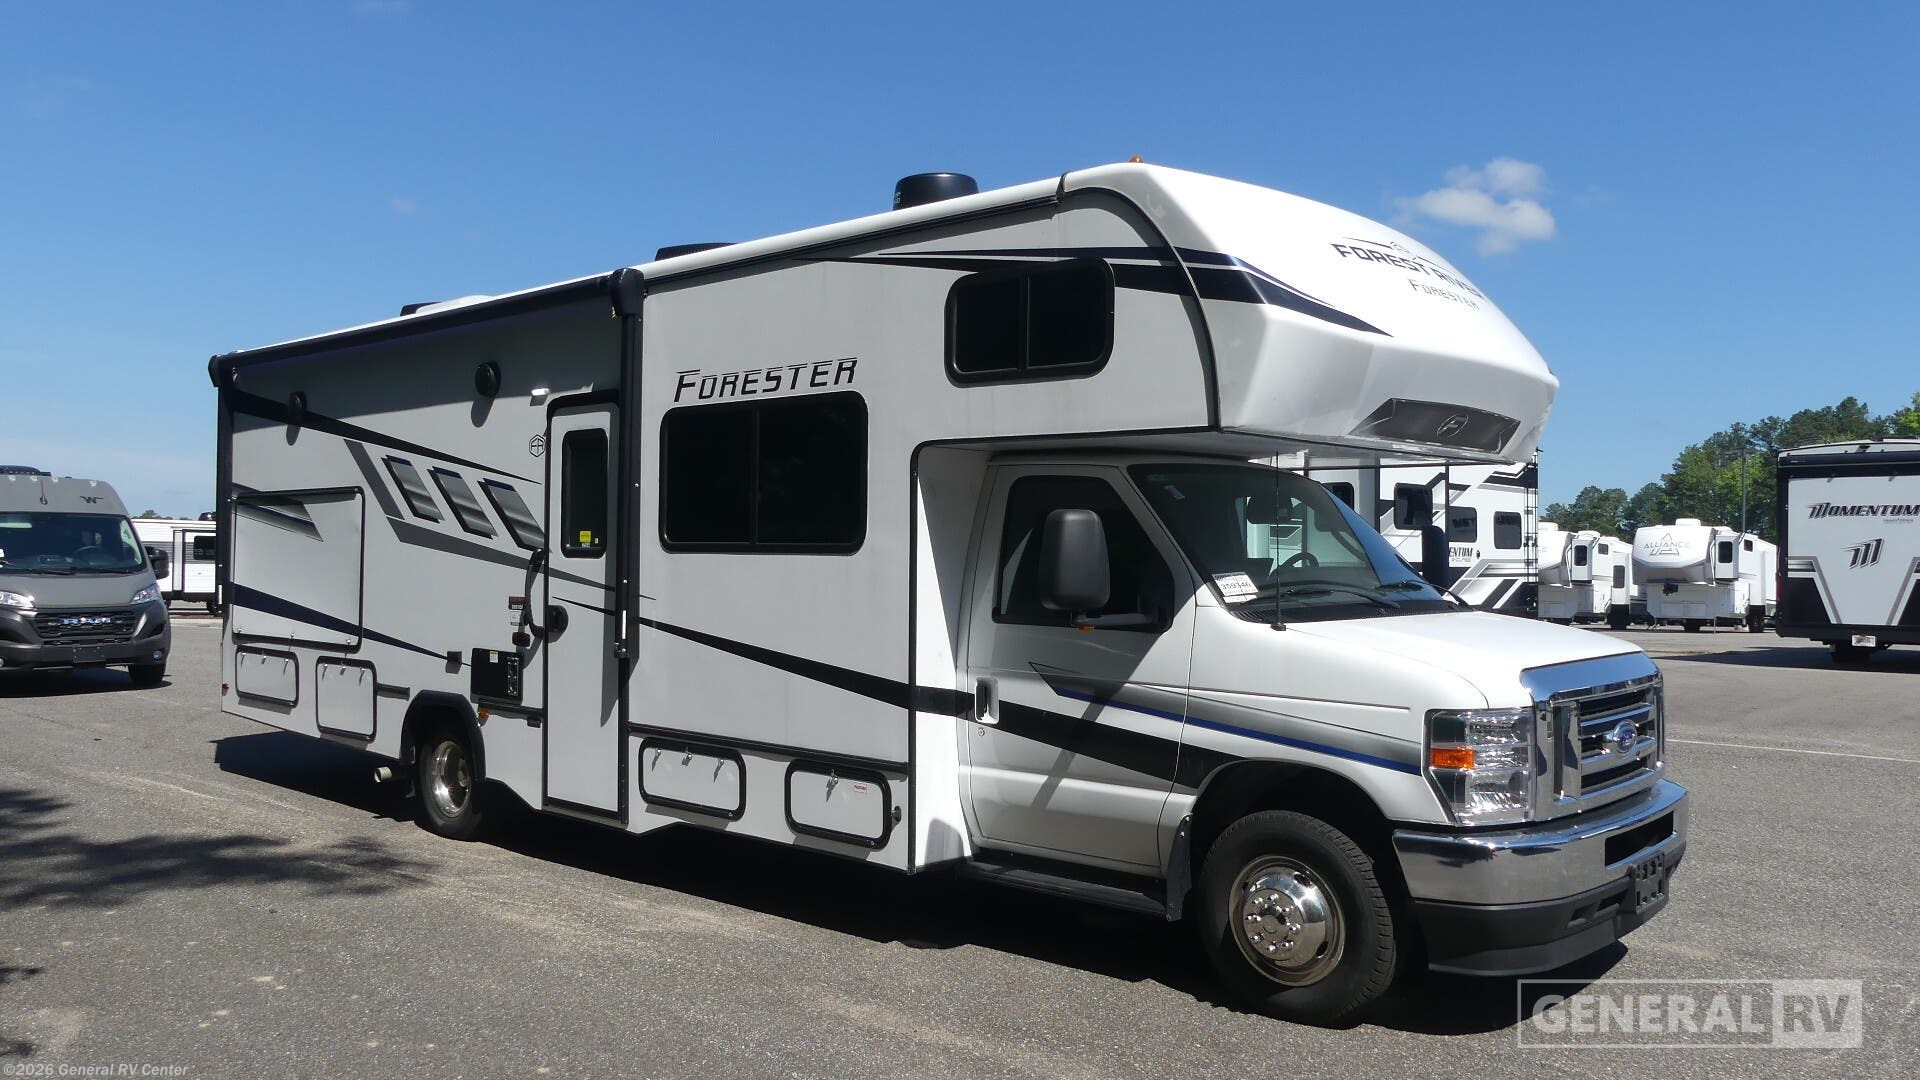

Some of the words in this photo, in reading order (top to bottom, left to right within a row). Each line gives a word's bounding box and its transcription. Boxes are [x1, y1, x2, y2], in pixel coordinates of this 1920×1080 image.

[1330, 243, 1431, 276] FOREST
[674, 357, 858, 402] FORESTER
[1807, 502, 1920, 519] MOMENTUM
[1449, 546, 1474, 558] ENTUM
